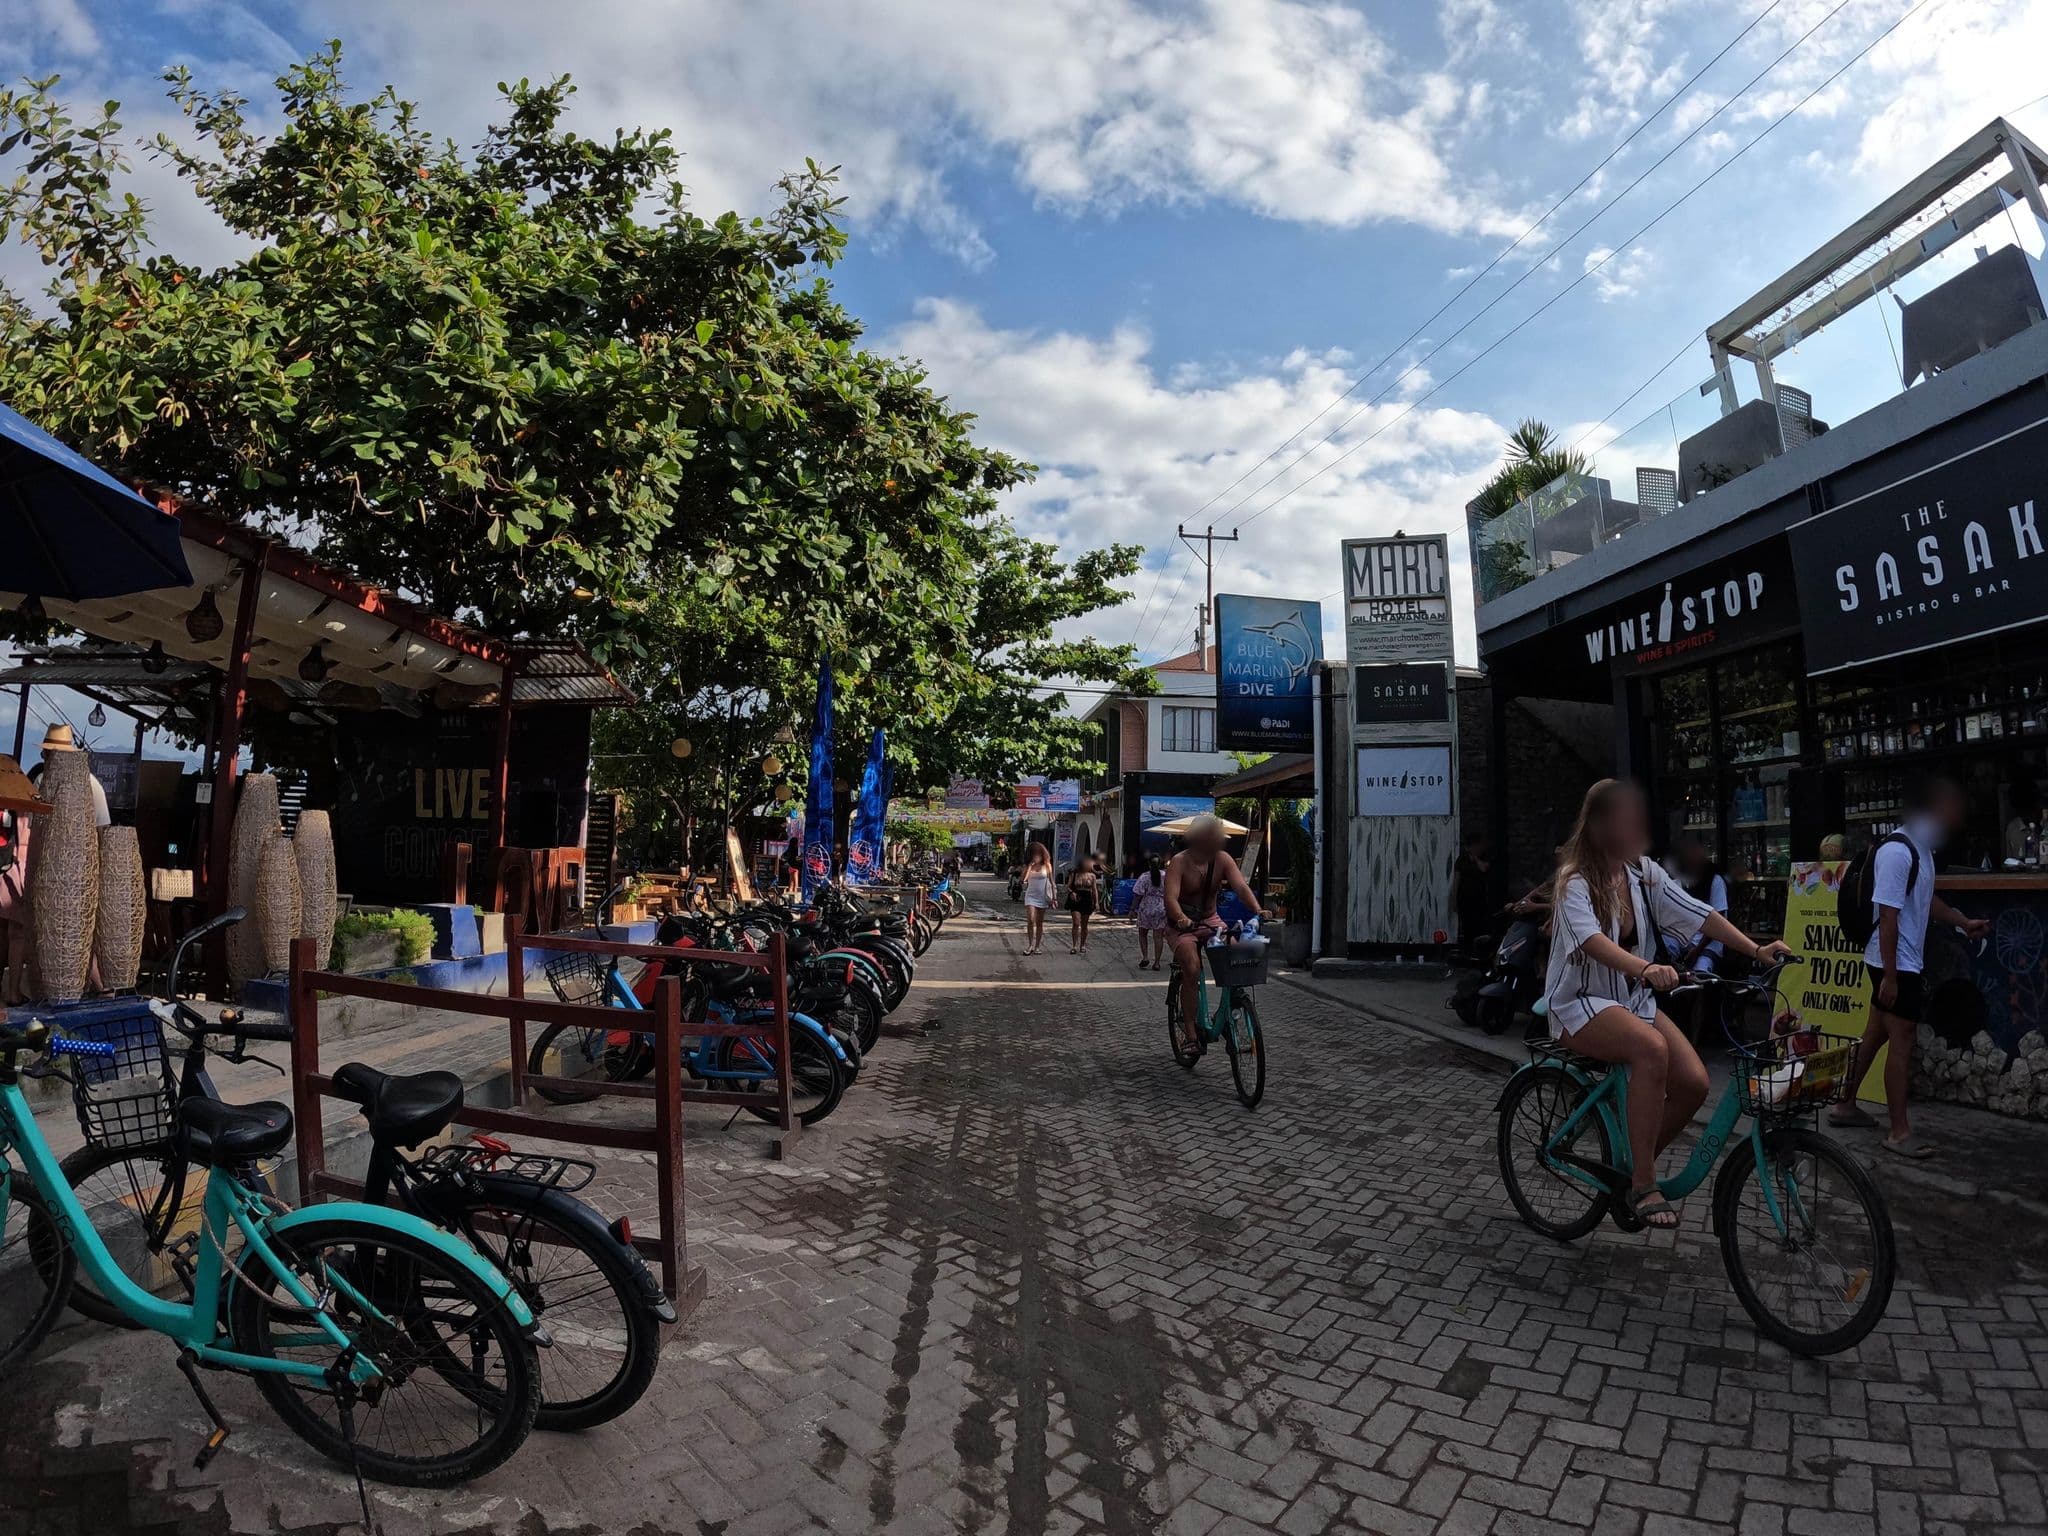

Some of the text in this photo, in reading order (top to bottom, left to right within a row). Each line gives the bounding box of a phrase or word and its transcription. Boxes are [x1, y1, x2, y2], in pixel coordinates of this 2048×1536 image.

[1900, 499, 1948, 533] THE
[1835, 499, 2046, 612] SASAK
[1348, 541, 1444, 597] MARC
[1370, 600, 1427, 616] HOTEL
[1876, 599, 1941, 625] BISTRO
[1974, 579, 2013, 599] BAR
[1585, 571, 1765, 665] WINE STOP
[1238, 644, 1273, 658] BLUE
[1636, 646, 1665, 664] WINE
[1229, 662, 1284, 679] MARLIN
[1239, 683, 1275, 697] DIVE
[1373, 684, 1429, 698] SASAK
[1272, 719, 1290, 728] PADI
[1366, 775, 1443, 787] WINE STOP
[415, 768, 491, 819] LIVE
[1810, 958, 1865, 988] TO GO!
[1802, 991, 1829, 1010] ONLY
[1701, 1135, 1719, 1163] ofo
[47, 1199, 75, 1242] ofo
